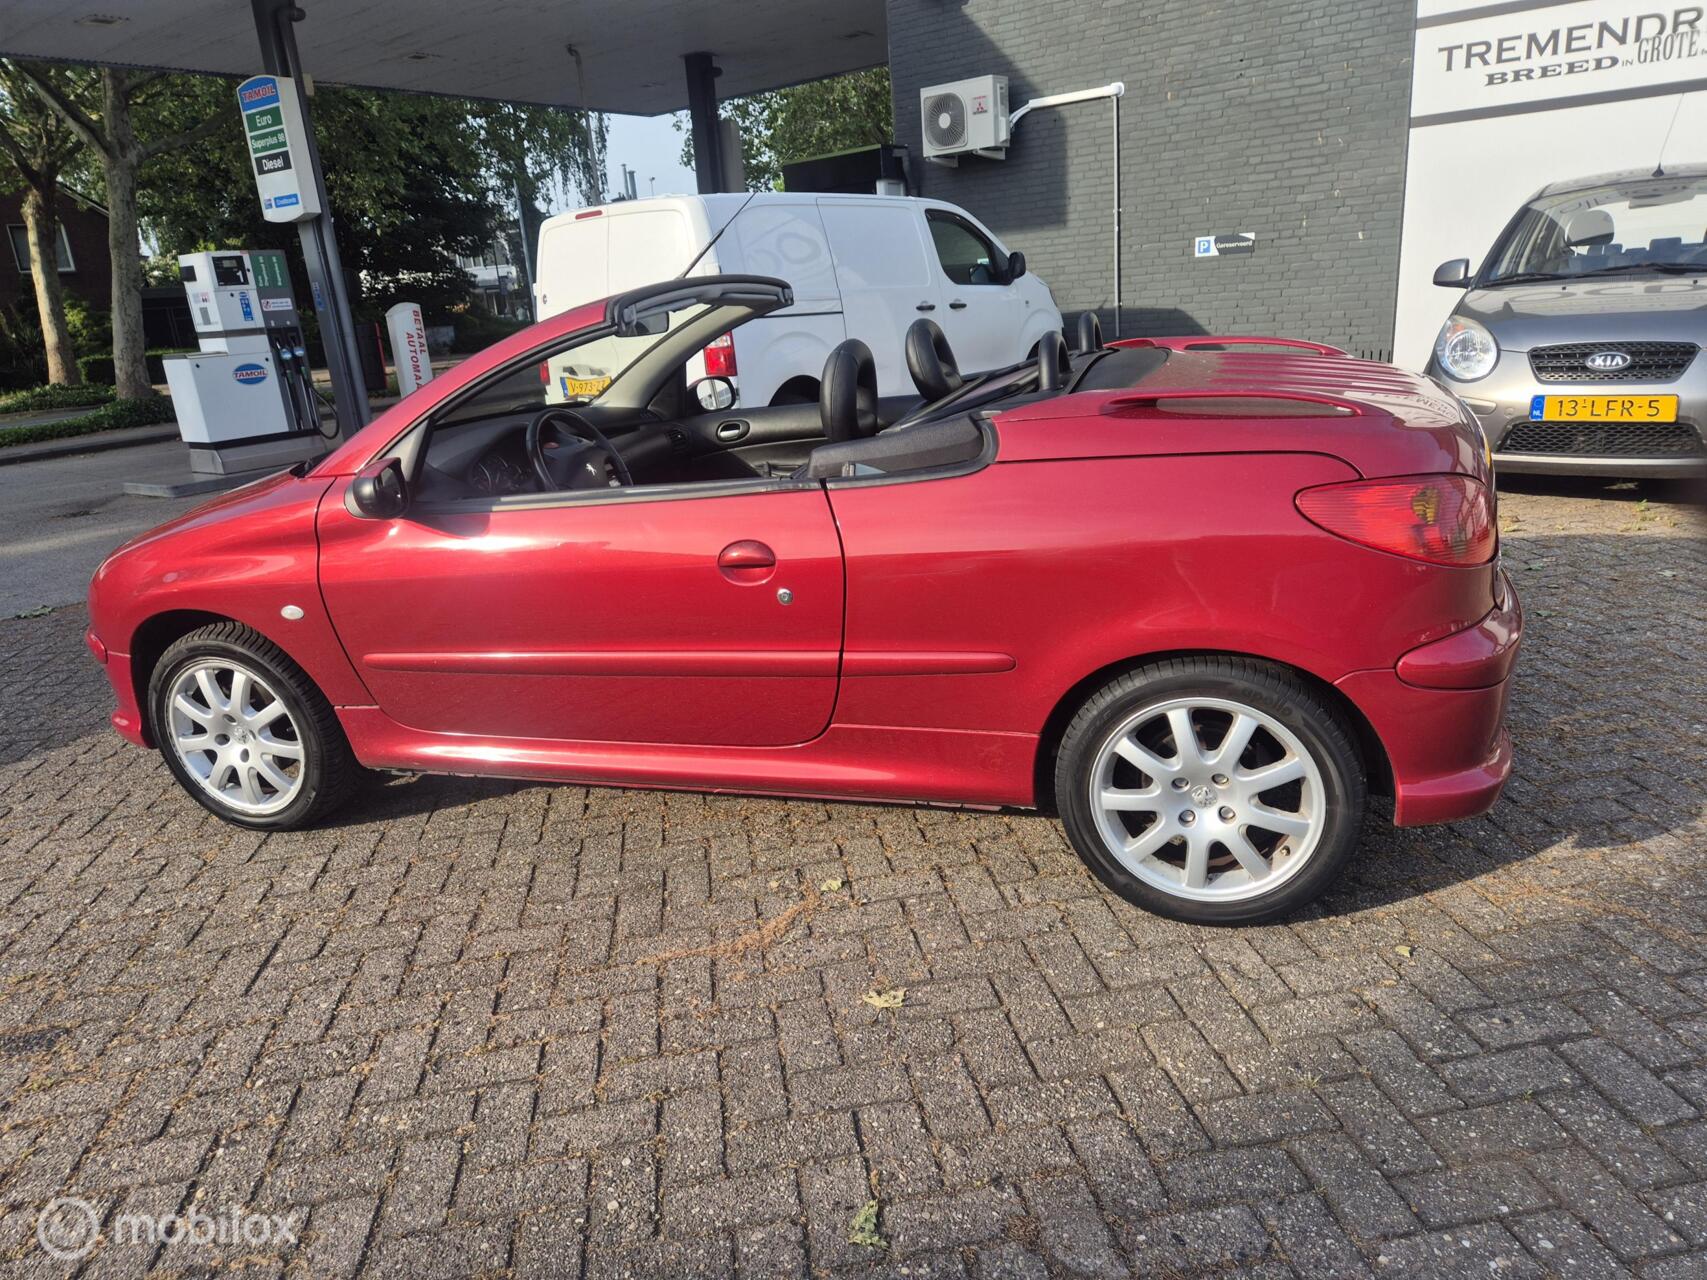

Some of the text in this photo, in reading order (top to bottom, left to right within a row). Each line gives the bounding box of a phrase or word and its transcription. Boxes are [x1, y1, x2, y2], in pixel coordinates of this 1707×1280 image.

[1485, 29, 1700, 86] BREED IN GROTE
[241, 84, 276, 102] TAMOIL
[255, 114, 272, 127] Euro
[252, 136, 278, 149] Superplus
[262, 156, 284, 171] Diesel
[236, 270, 244, 283] 1
[412, 309, 426, 355] BETAAL
[1594, 355, 1622, 366] KIA
[233, 369, 267, 379] TAMOIL
[1557, 399, 1660, 417] 13-LFR-5
